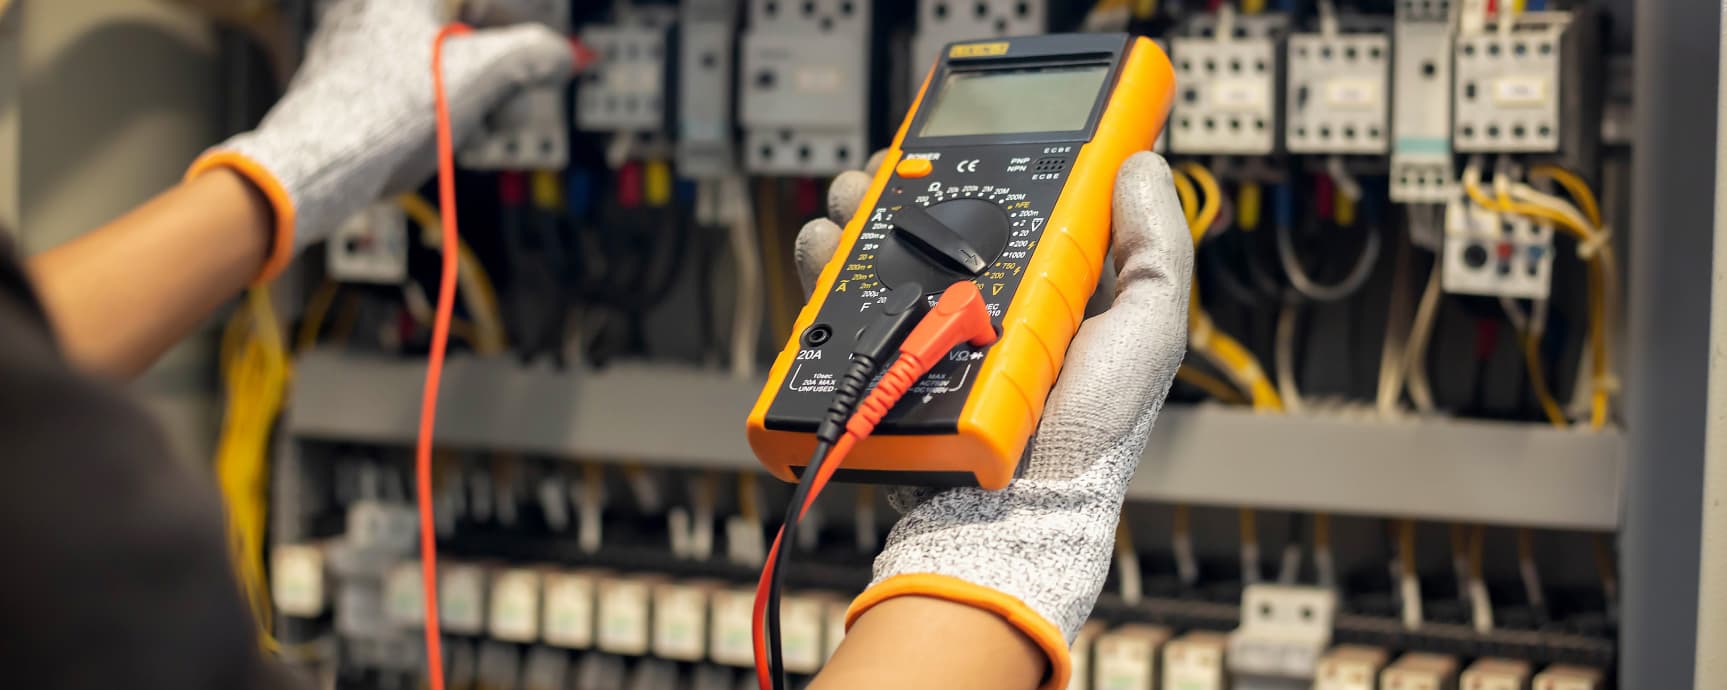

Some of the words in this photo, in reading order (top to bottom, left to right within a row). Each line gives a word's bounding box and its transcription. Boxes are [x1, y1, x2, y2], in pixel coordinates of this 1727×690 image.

[957, 160, 979, 172] CE
[860, 302, 872, 312] F
[797, 350, 822, 360] 20A
